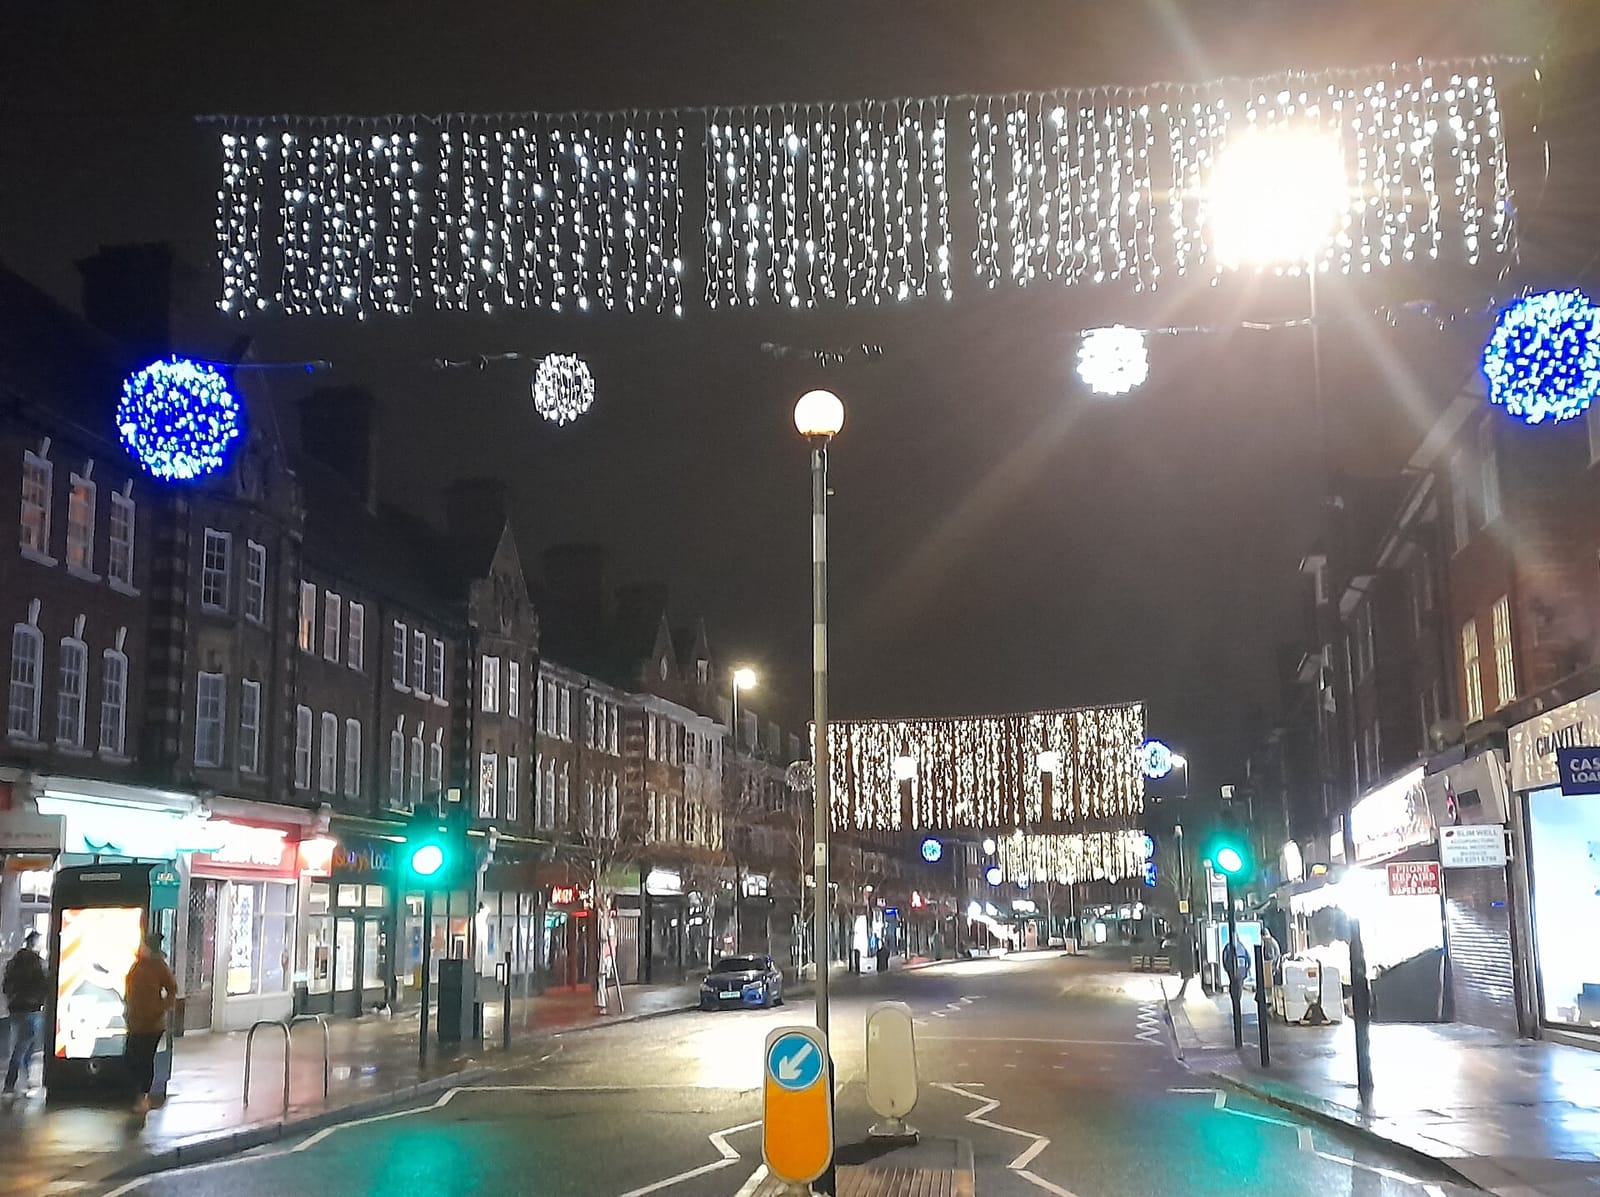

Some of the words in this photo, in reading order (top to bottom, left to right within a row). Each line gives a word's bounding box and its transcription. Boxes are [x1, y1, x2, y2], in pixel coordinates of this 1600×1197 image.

[1572, 771, 1600, 783] LOA
[1396, 863, 1430, 873] PHONE
[1417, 886, 1438, 894] SHOP
